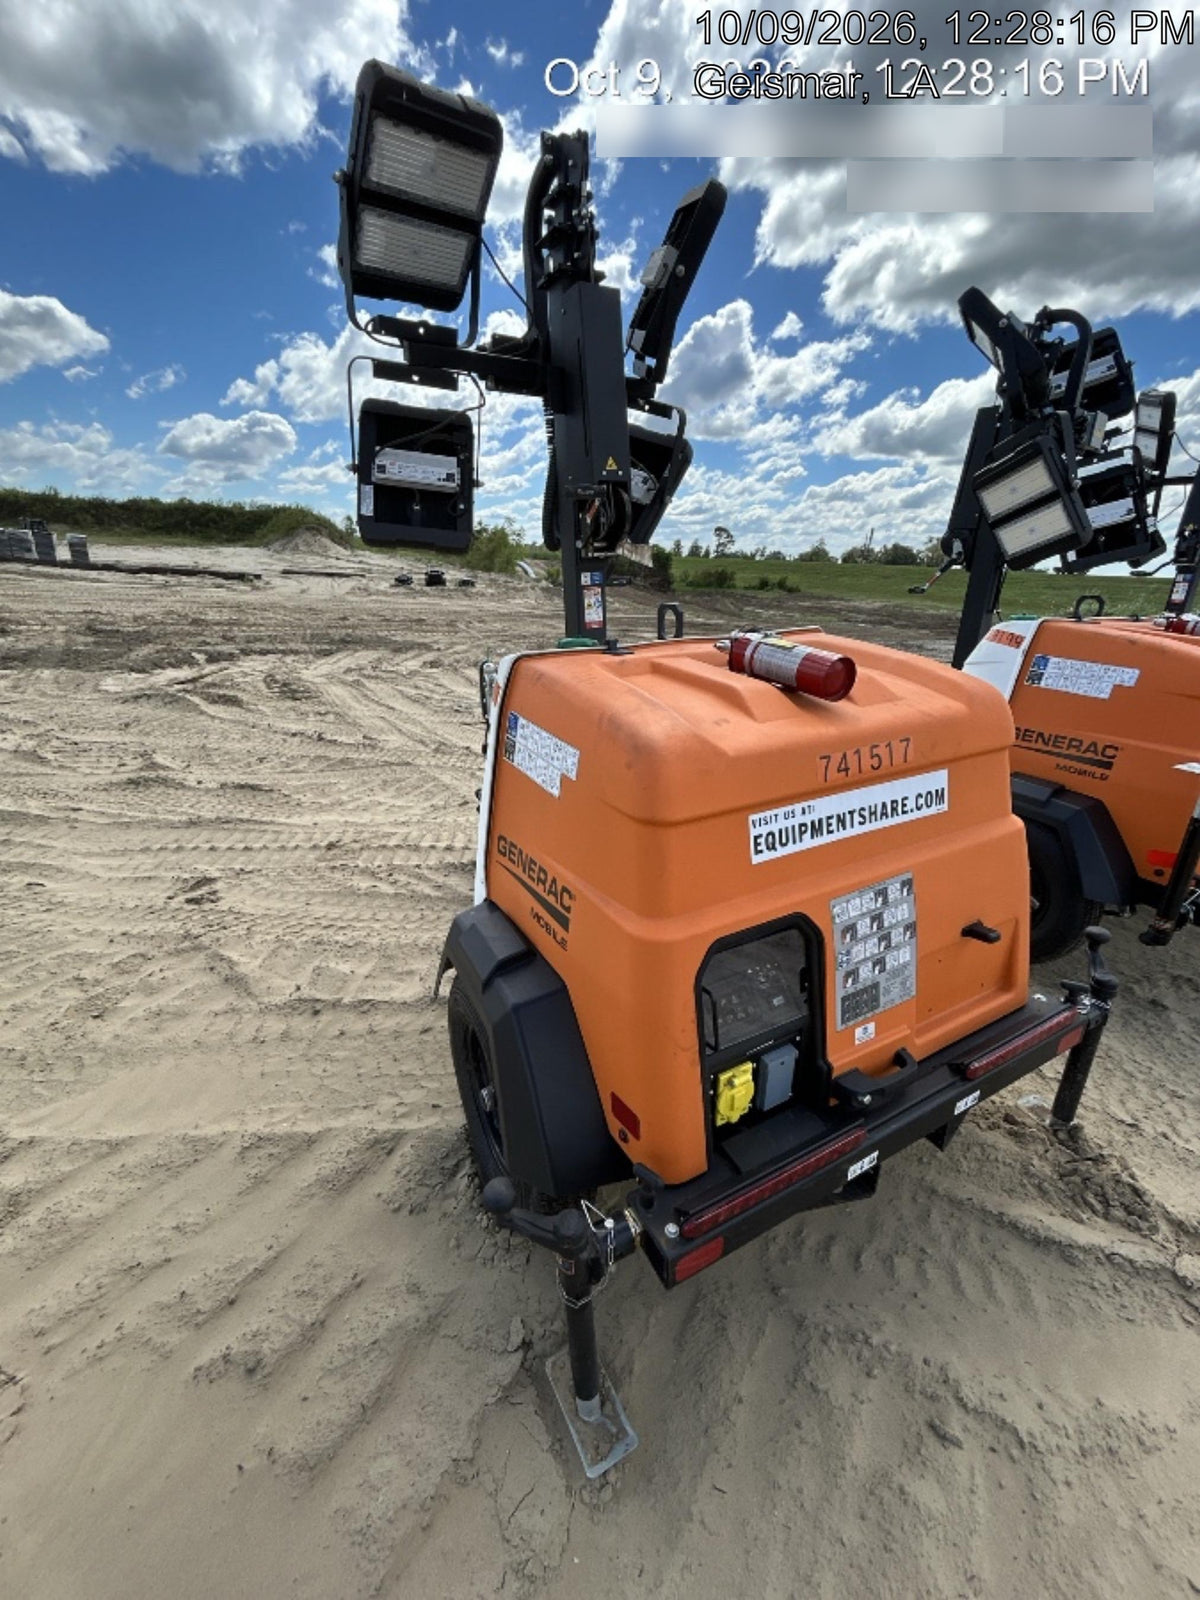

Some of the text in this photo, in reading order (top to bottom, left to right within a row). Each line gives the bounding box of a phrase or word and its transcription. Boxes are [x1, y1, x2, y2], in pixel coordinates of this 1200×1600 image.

[819, 736, 912, 783] 741517
[751, 813, 779, 829] VISIT
[783, 808, 796, 821] US
[753, 786, 946, 855] EQUIPMENTSHARE.COM
[496, 834, 573, 914] GENERAC
